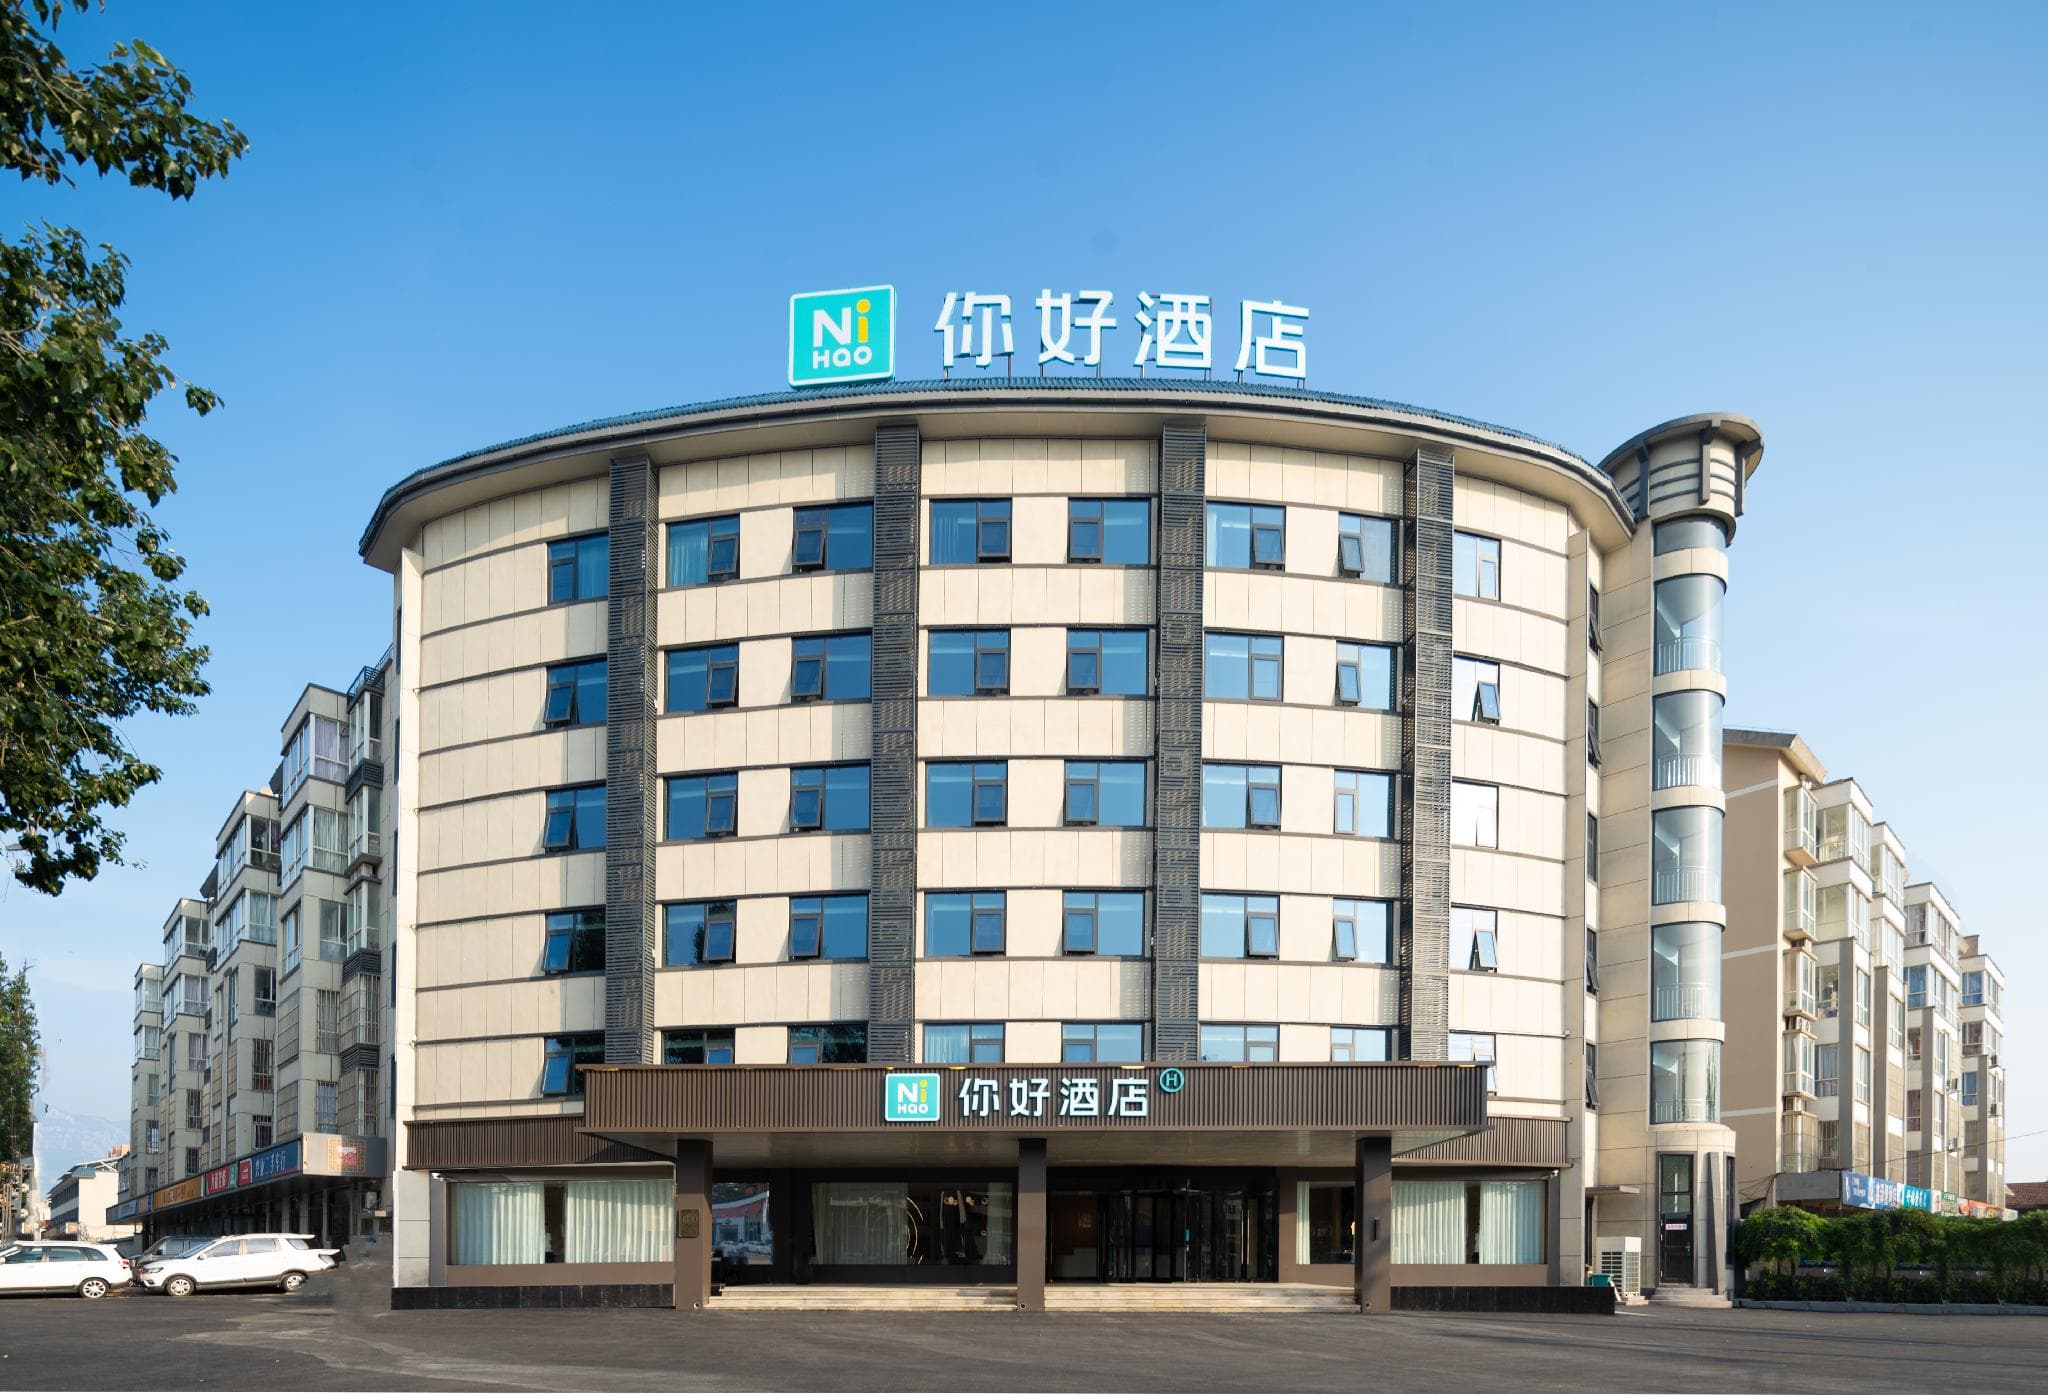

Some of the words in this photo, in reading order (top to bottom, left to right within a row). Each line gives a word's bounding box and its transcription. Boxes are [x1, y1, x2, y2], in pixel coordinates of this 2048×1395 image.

[813, 298, 871, 347] Ni
[934, 288, 1310, 379] 你好酒店
[897, 1079, 928, 1103] Ni
[958, 1077, 1150, 1117] 你好酒店
